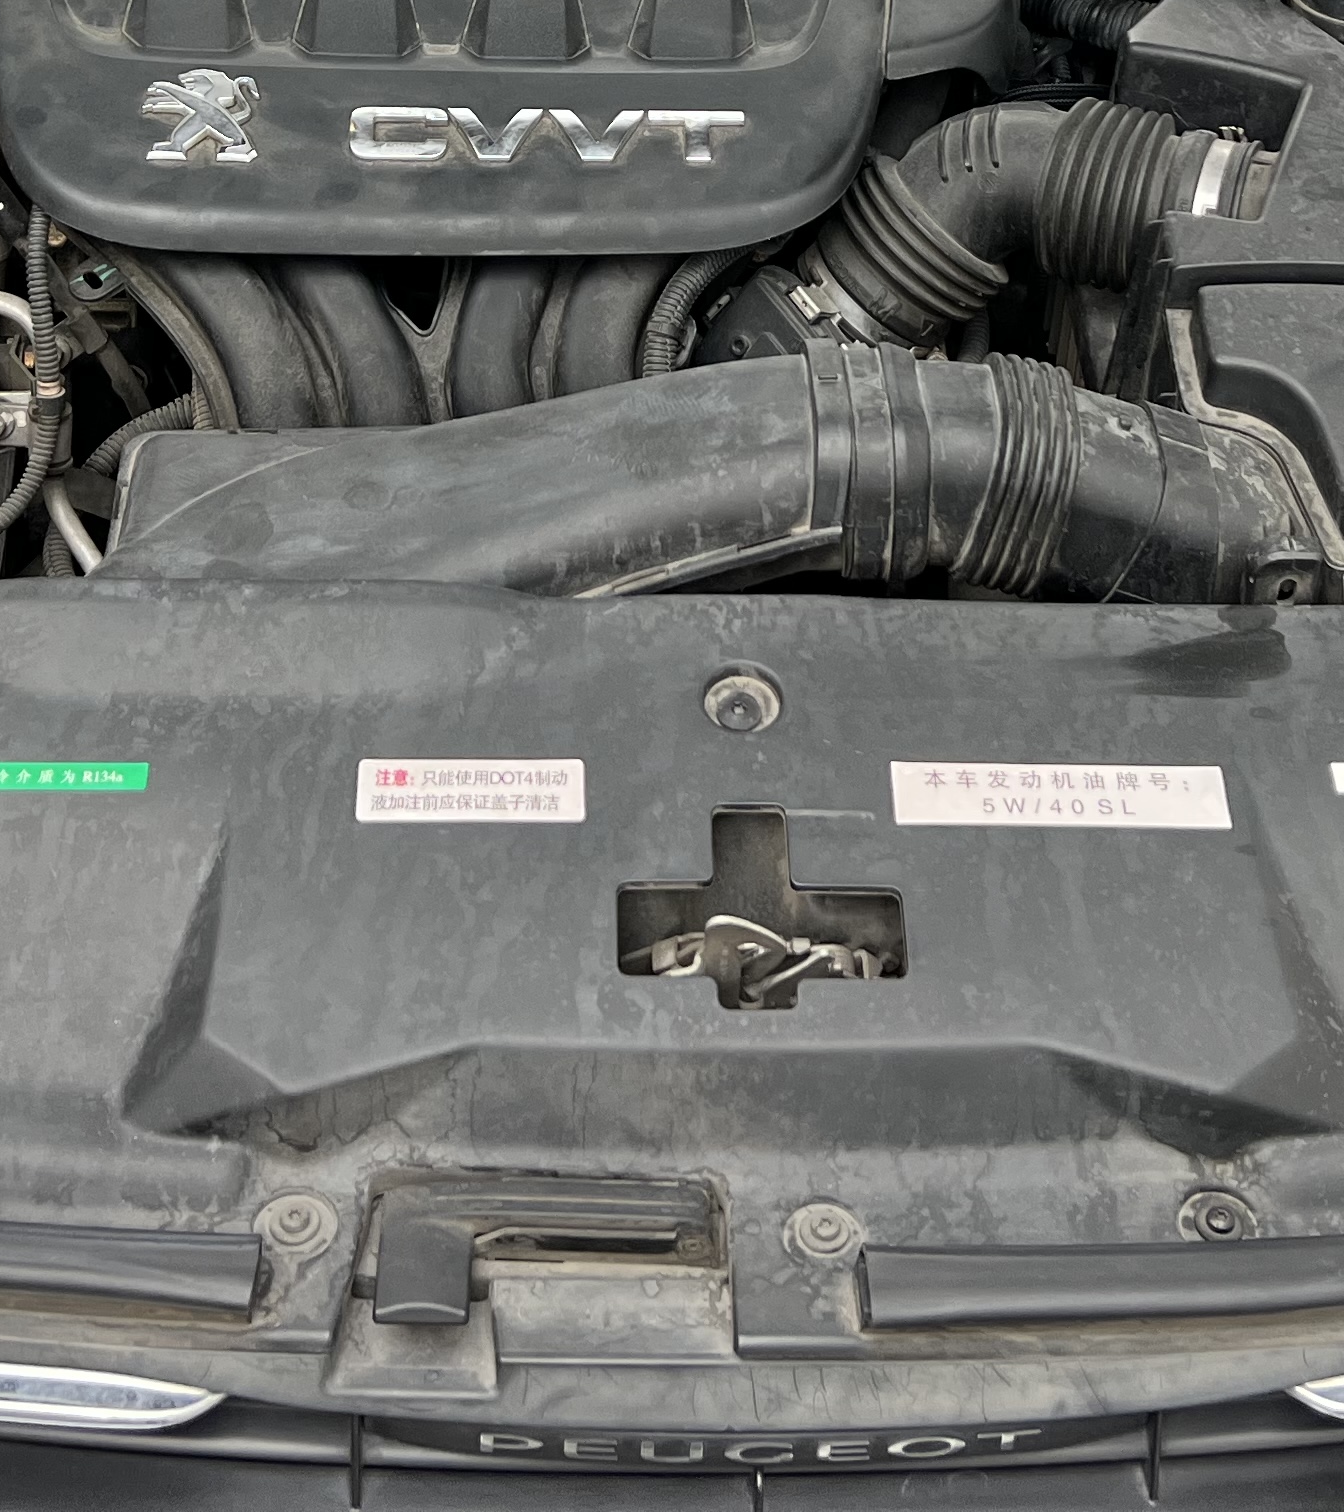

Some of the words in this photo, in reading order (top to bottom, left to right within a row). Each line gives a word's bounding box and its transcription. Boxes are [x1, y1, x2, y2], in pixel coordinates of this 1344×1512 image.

[348, 105, 746, 164] CVVT
[370, 793, 561, 811] 液加注前应保证盖子清洁
[478, 1427, 1044, 1465] PEUGEOT
